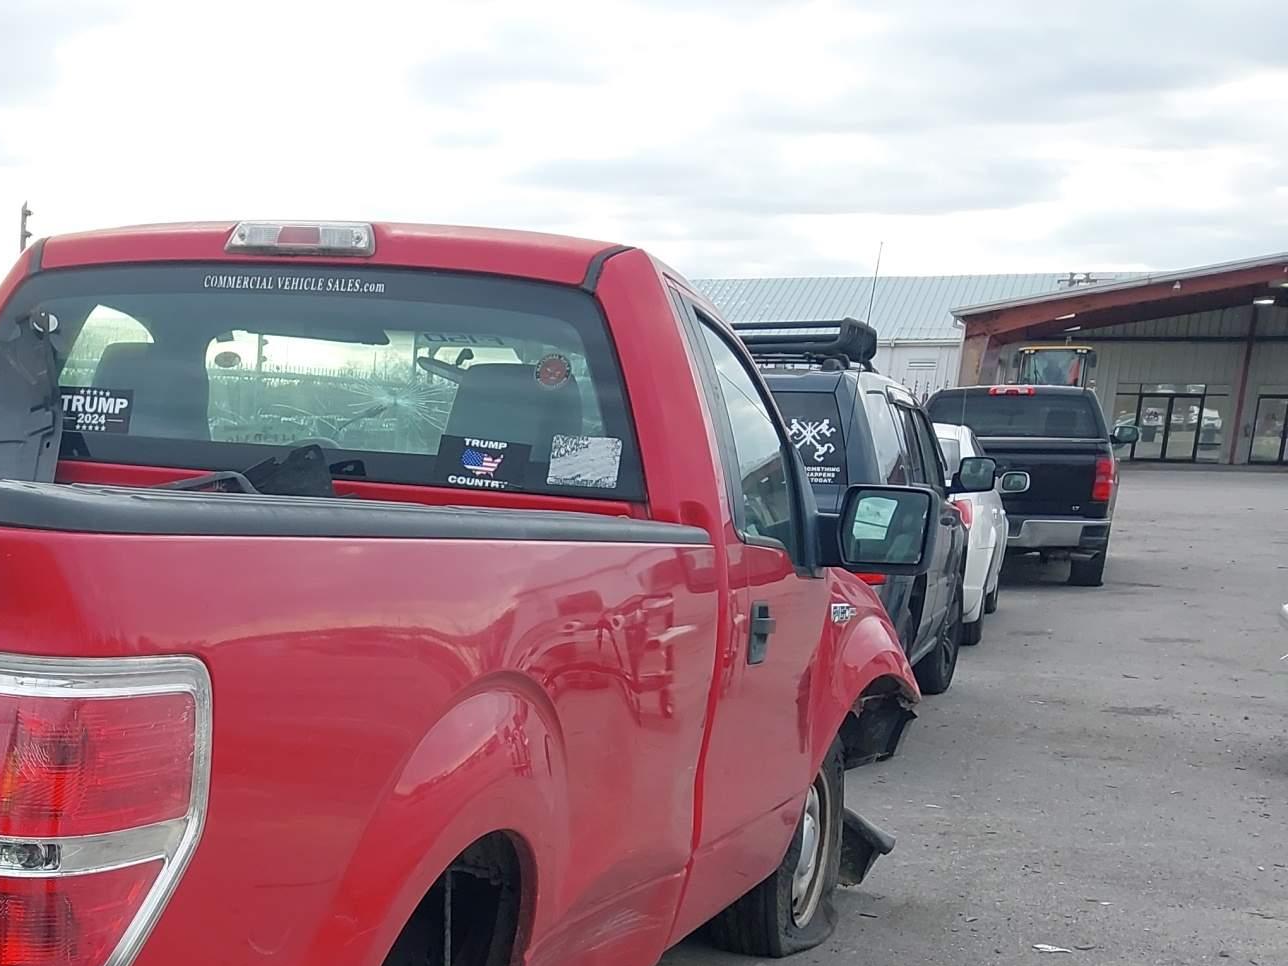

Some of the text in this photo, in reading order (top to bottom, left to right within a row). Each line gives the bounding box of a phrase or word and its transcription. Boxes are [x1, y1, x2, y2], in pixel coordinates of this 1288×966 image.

[204, 275, 385, 293] COMMERCIAL VEHICLE SALES.com
[61, 394, 129, 414] TRUMP
[76, 413, 106, 425] 2024
[464, 437, 508, 450] TRUMP
